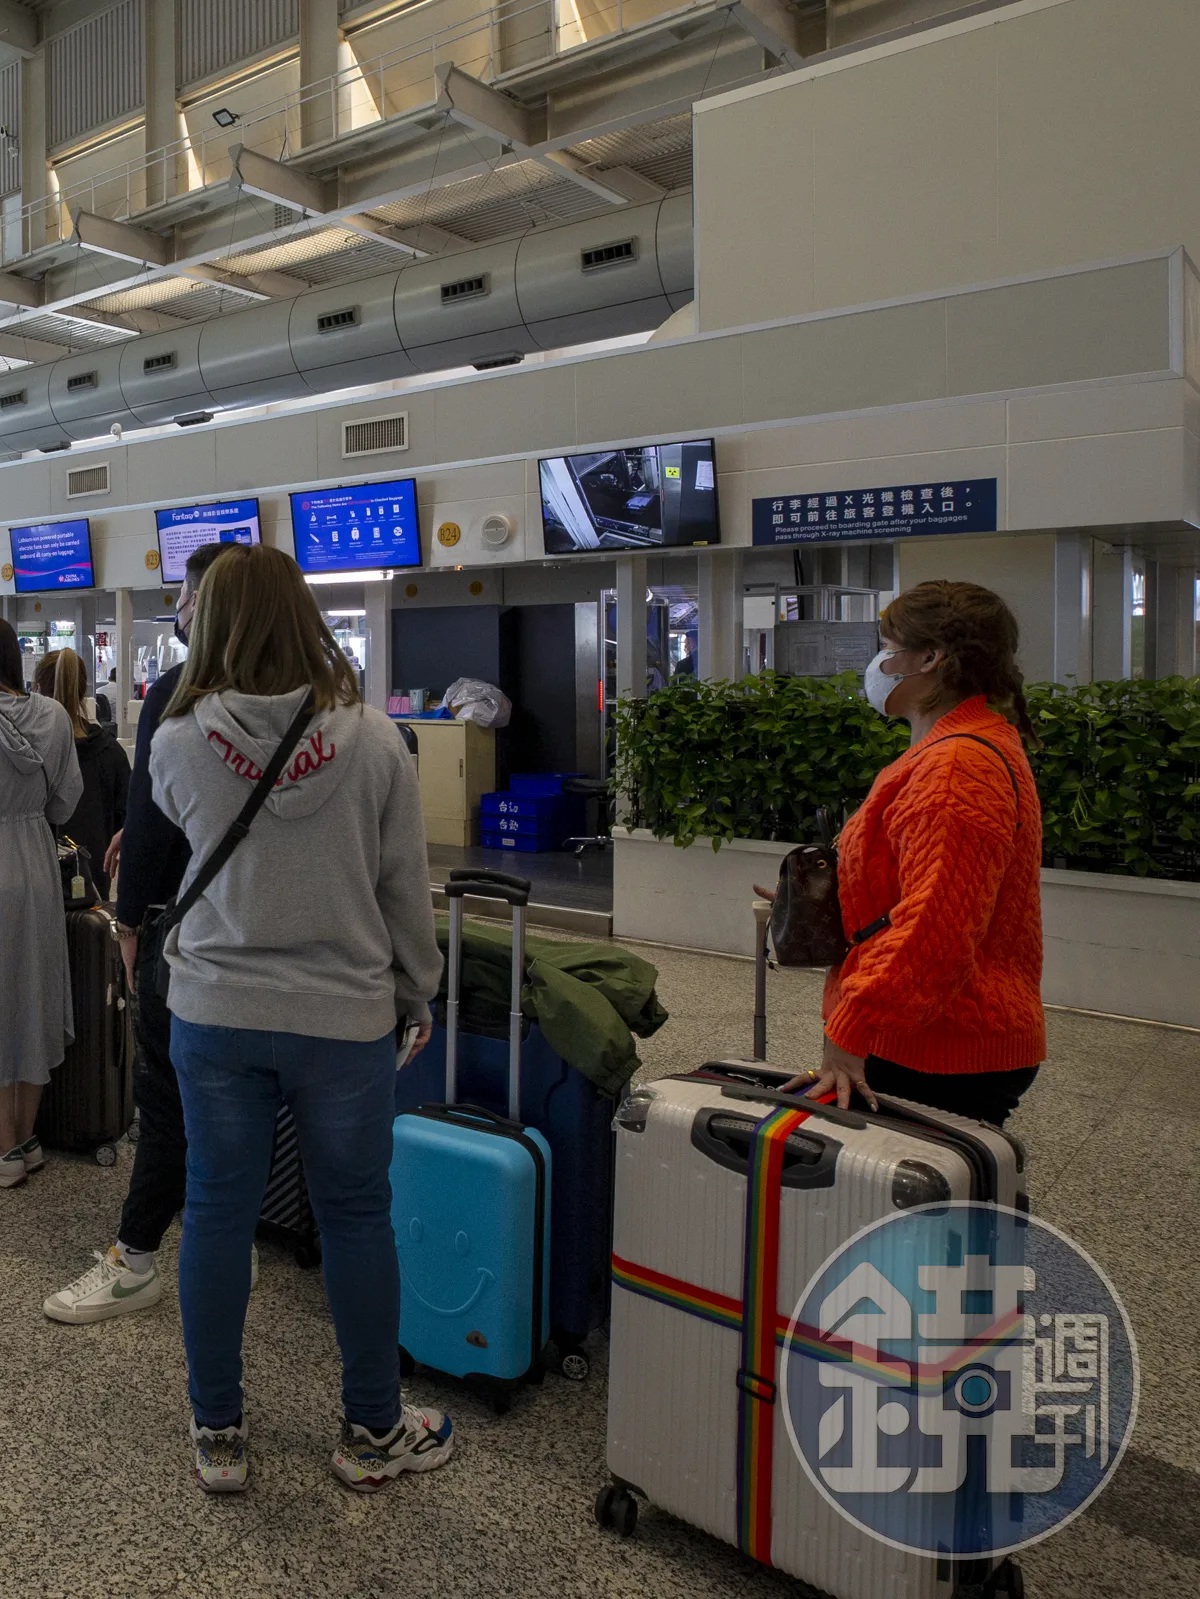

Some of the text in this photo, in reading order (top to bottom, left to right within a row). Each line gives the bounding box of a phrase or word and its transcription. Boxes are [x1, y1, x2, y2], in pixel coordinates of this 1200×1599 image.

[171, 512, 194, 522] Fantasy
[775, 525, 799, 533] Please
[800, 523, 829, 533] proceed
[838, 520, 871, 530] boarding
[872, 518, 889, 528] gate
[889, 517, 908, 526] after
[909, 516, 927, 525] your
[928, 513, 968, 523] baggages
[40, 534, 57, 542] powered
[57, 531, 74, 539] portable
[440, 527, 457, 542] B24
[775, 524, 912, 541] pass through X-ray machine screening
